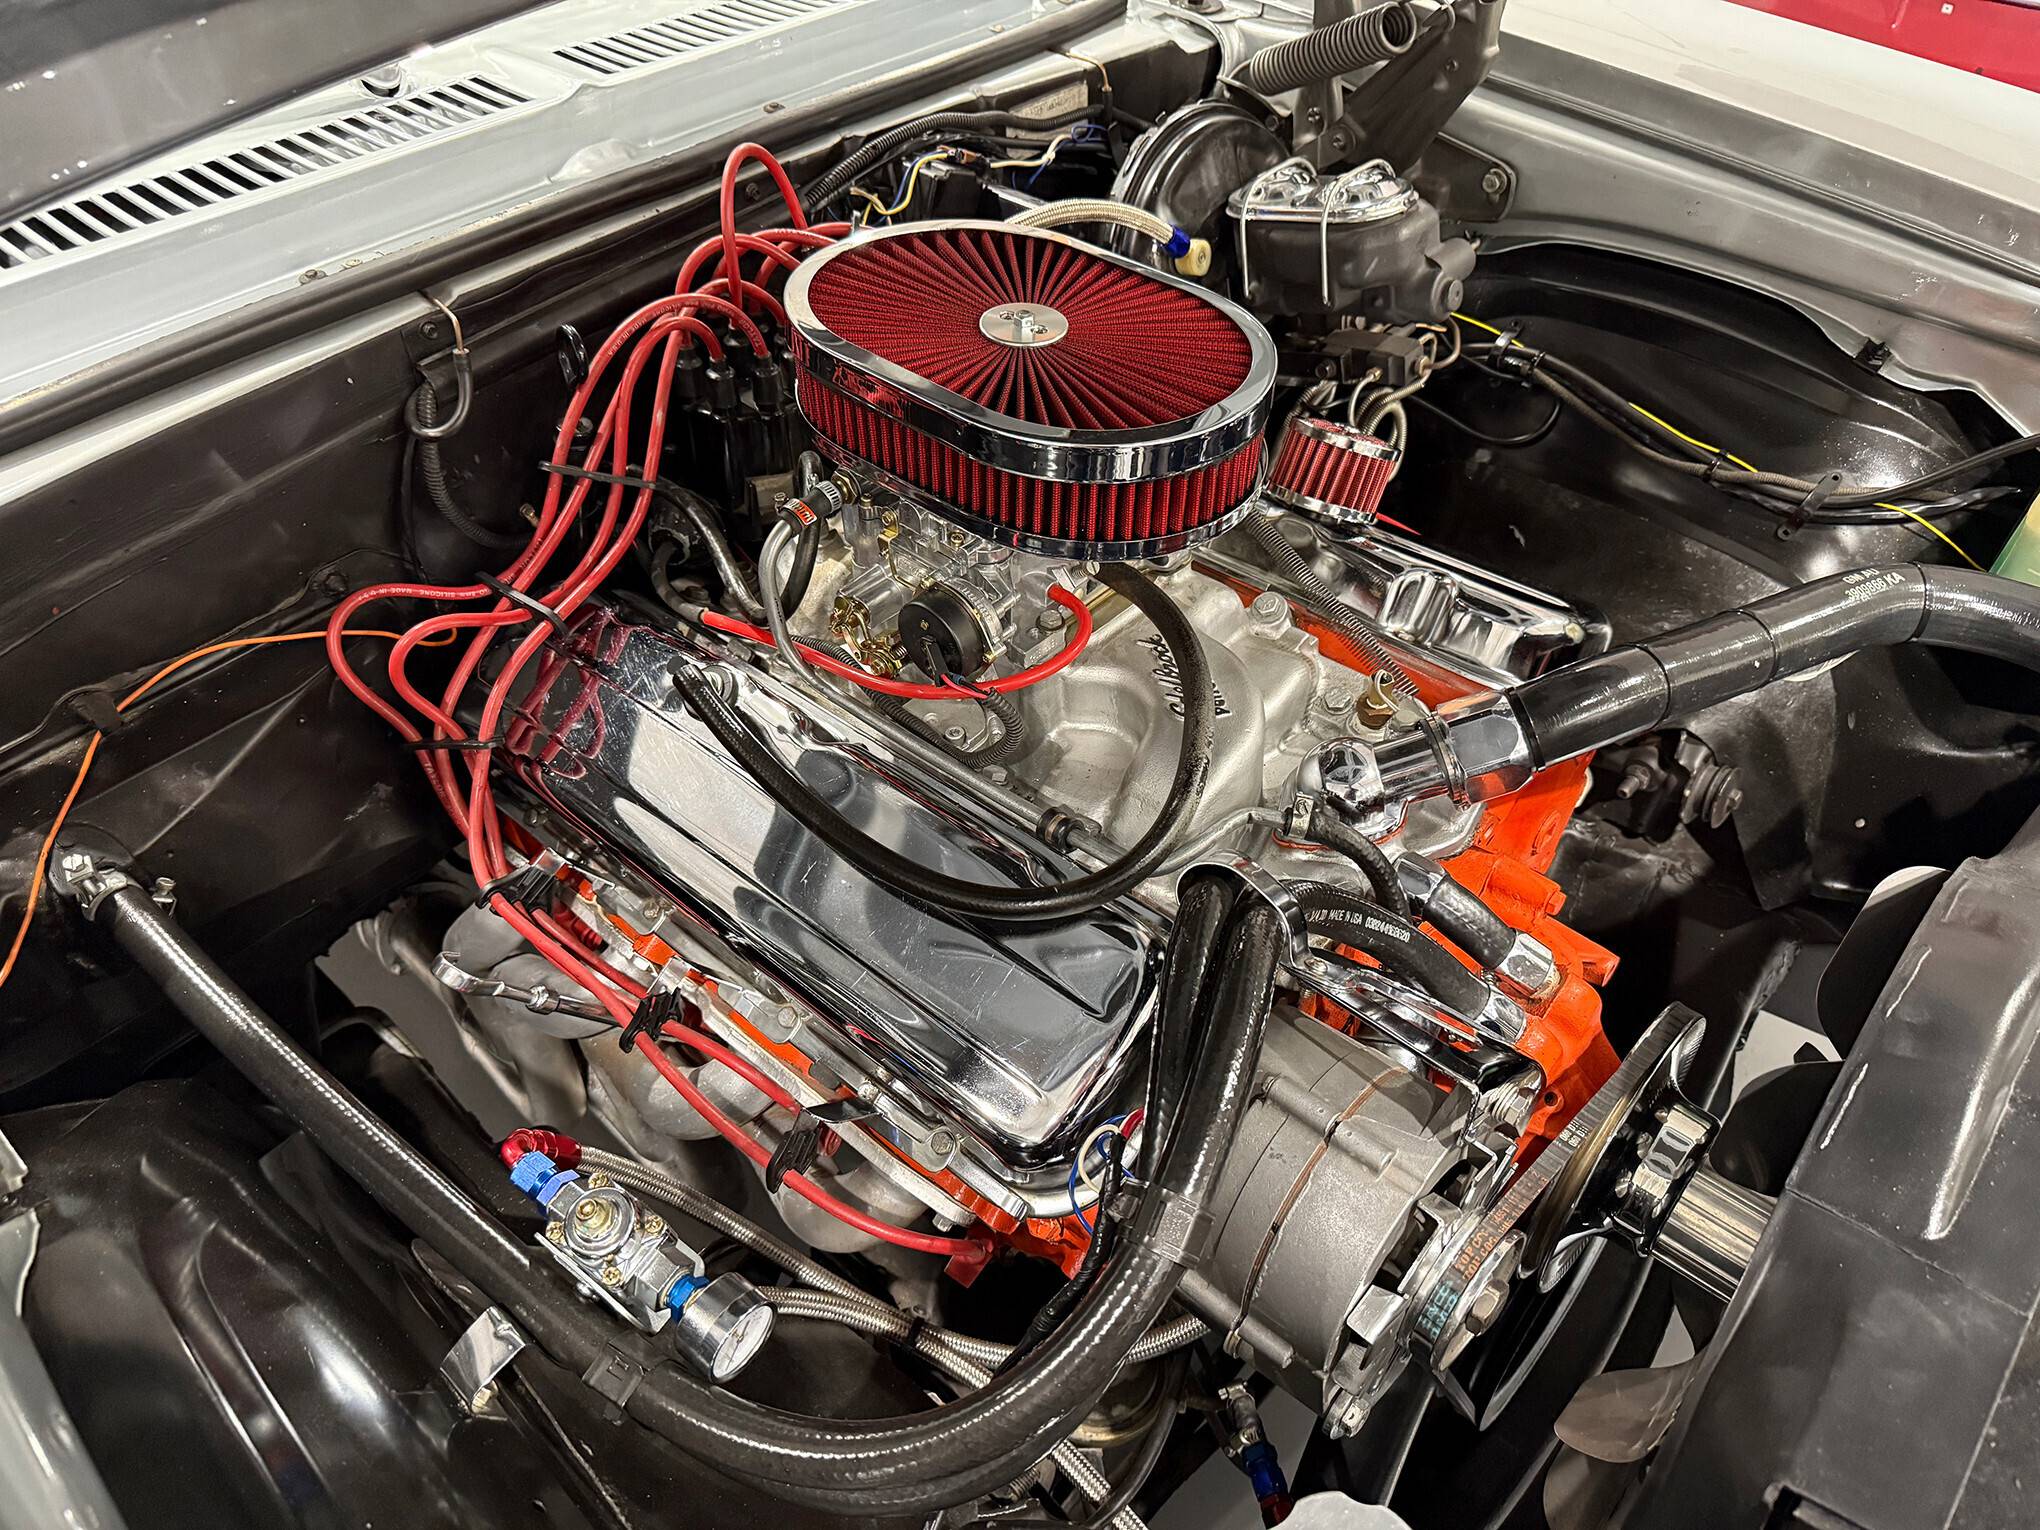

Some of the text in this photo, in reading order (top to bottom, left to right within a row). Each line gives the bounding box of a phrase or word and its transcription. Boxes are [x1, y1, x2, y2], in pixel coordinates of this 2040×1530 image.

[1842, 573, 1865, 584] GM
[1883, 572, 1906, 586] KA
[1454, 1246, 1475, 1272] TOP
